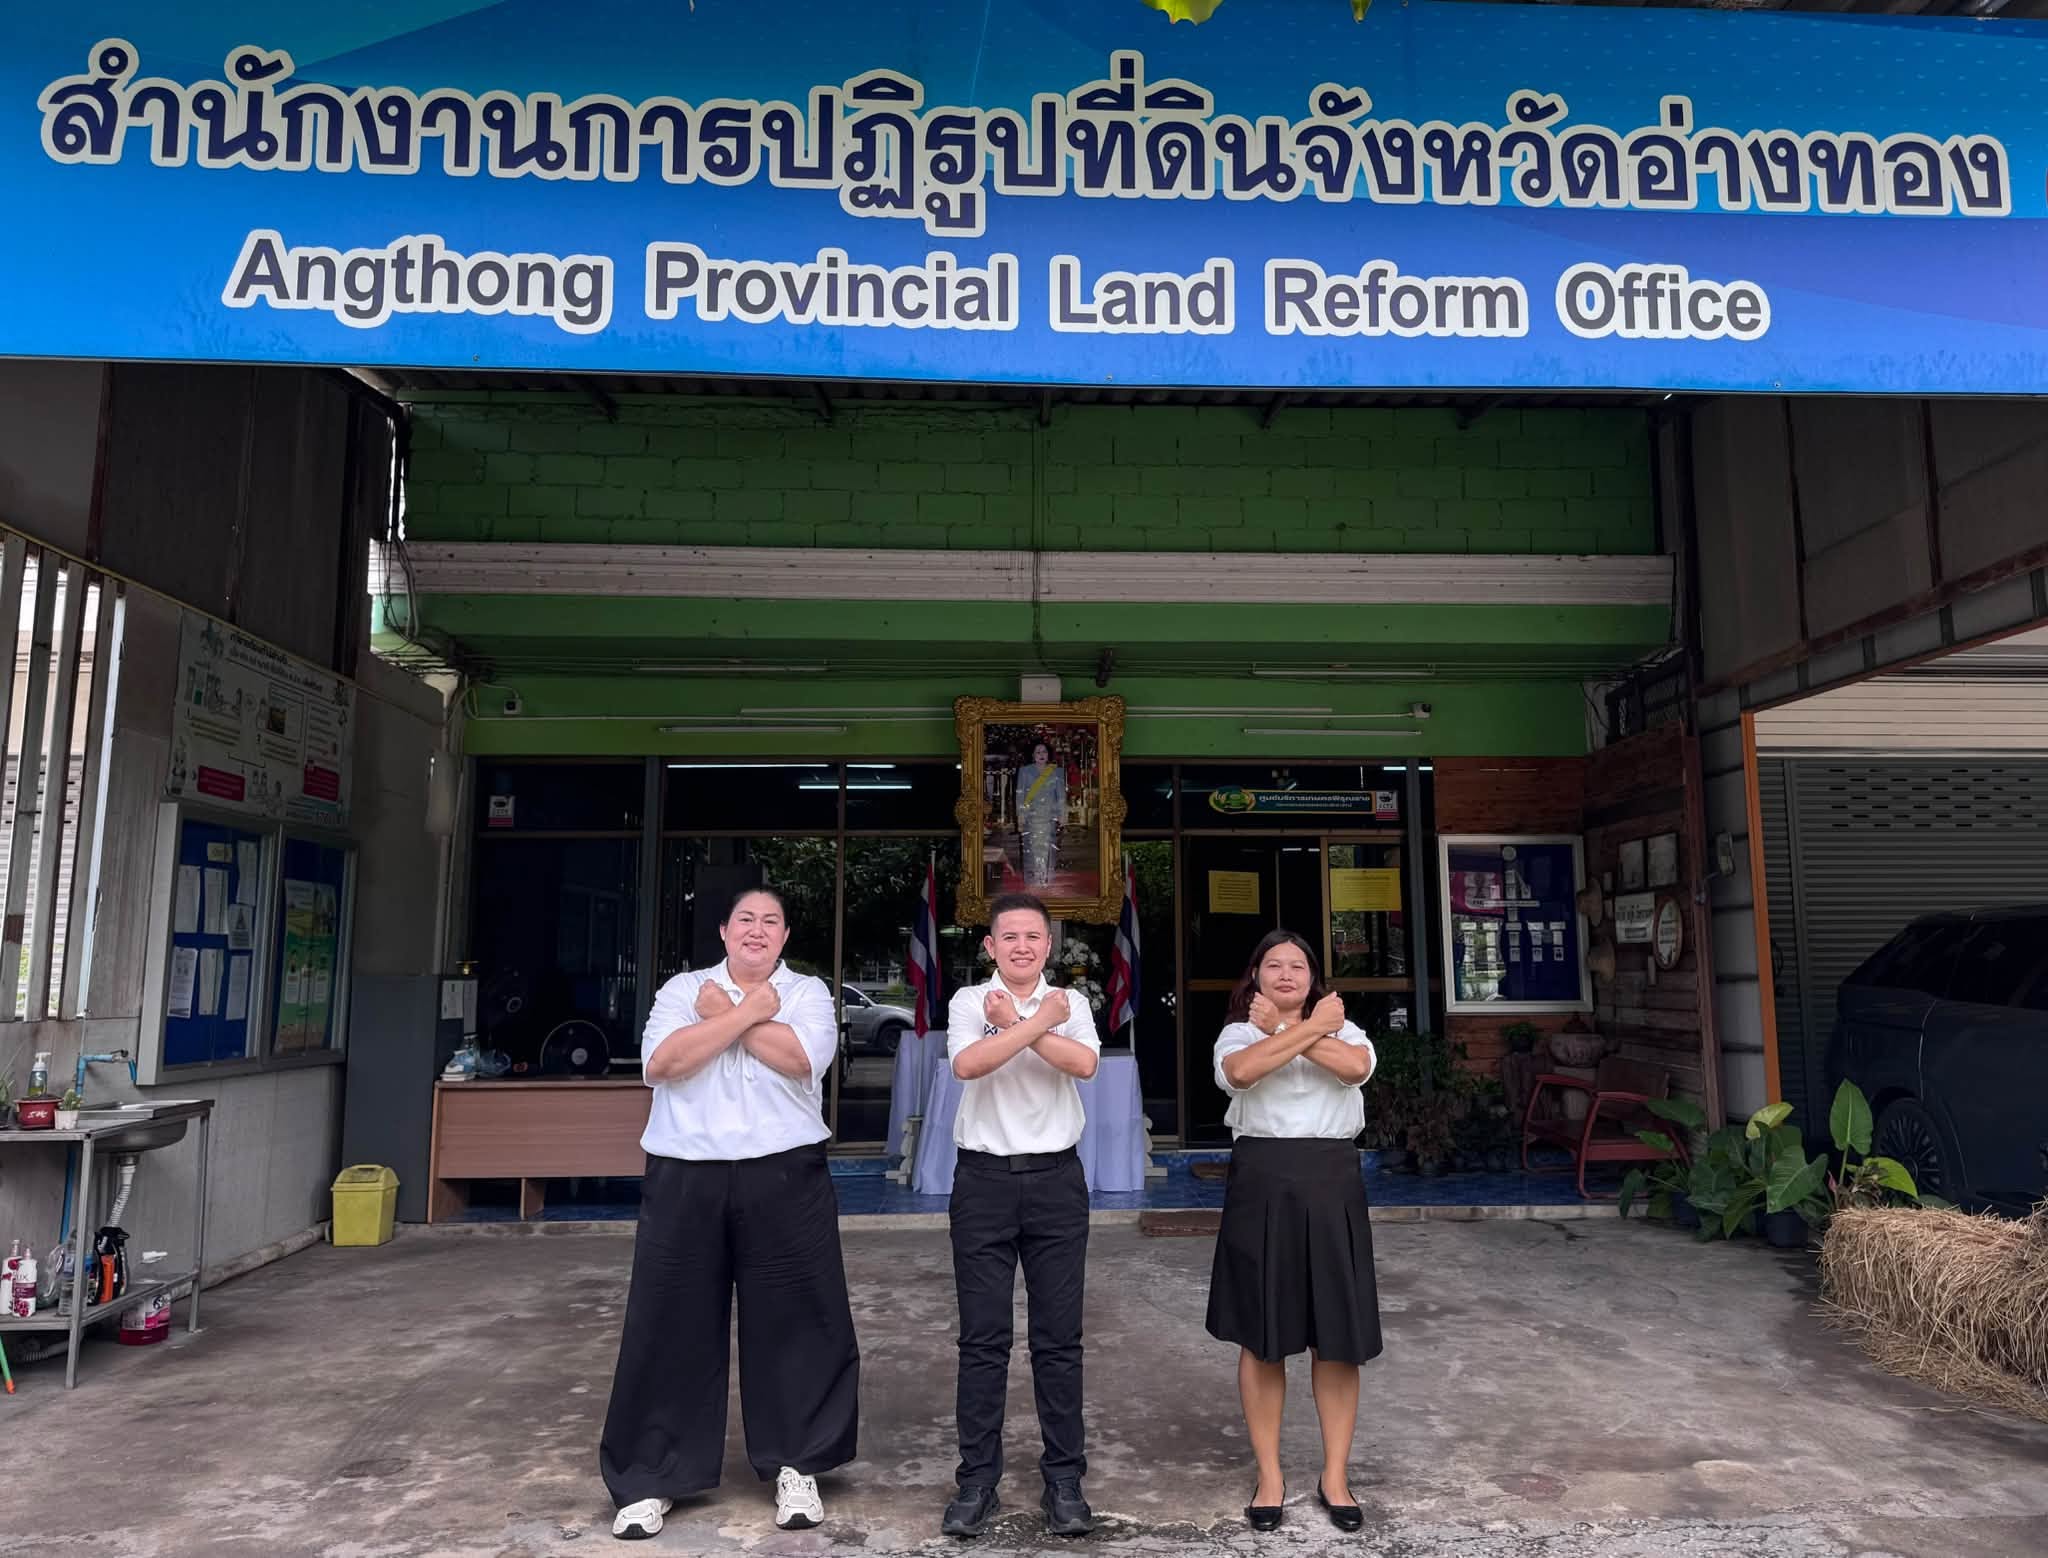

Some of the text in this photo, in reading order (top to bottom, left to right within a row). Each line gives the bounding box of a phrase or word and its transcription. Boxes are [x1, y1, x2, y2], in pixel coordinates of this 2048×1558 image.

[48, 46, 2003, 229] สำนักงานการปฏิรูปที่ดินจังหวัดอ่างทอง
[232, 238, 1762, 332] Angthong Provincial Land Reform Office
